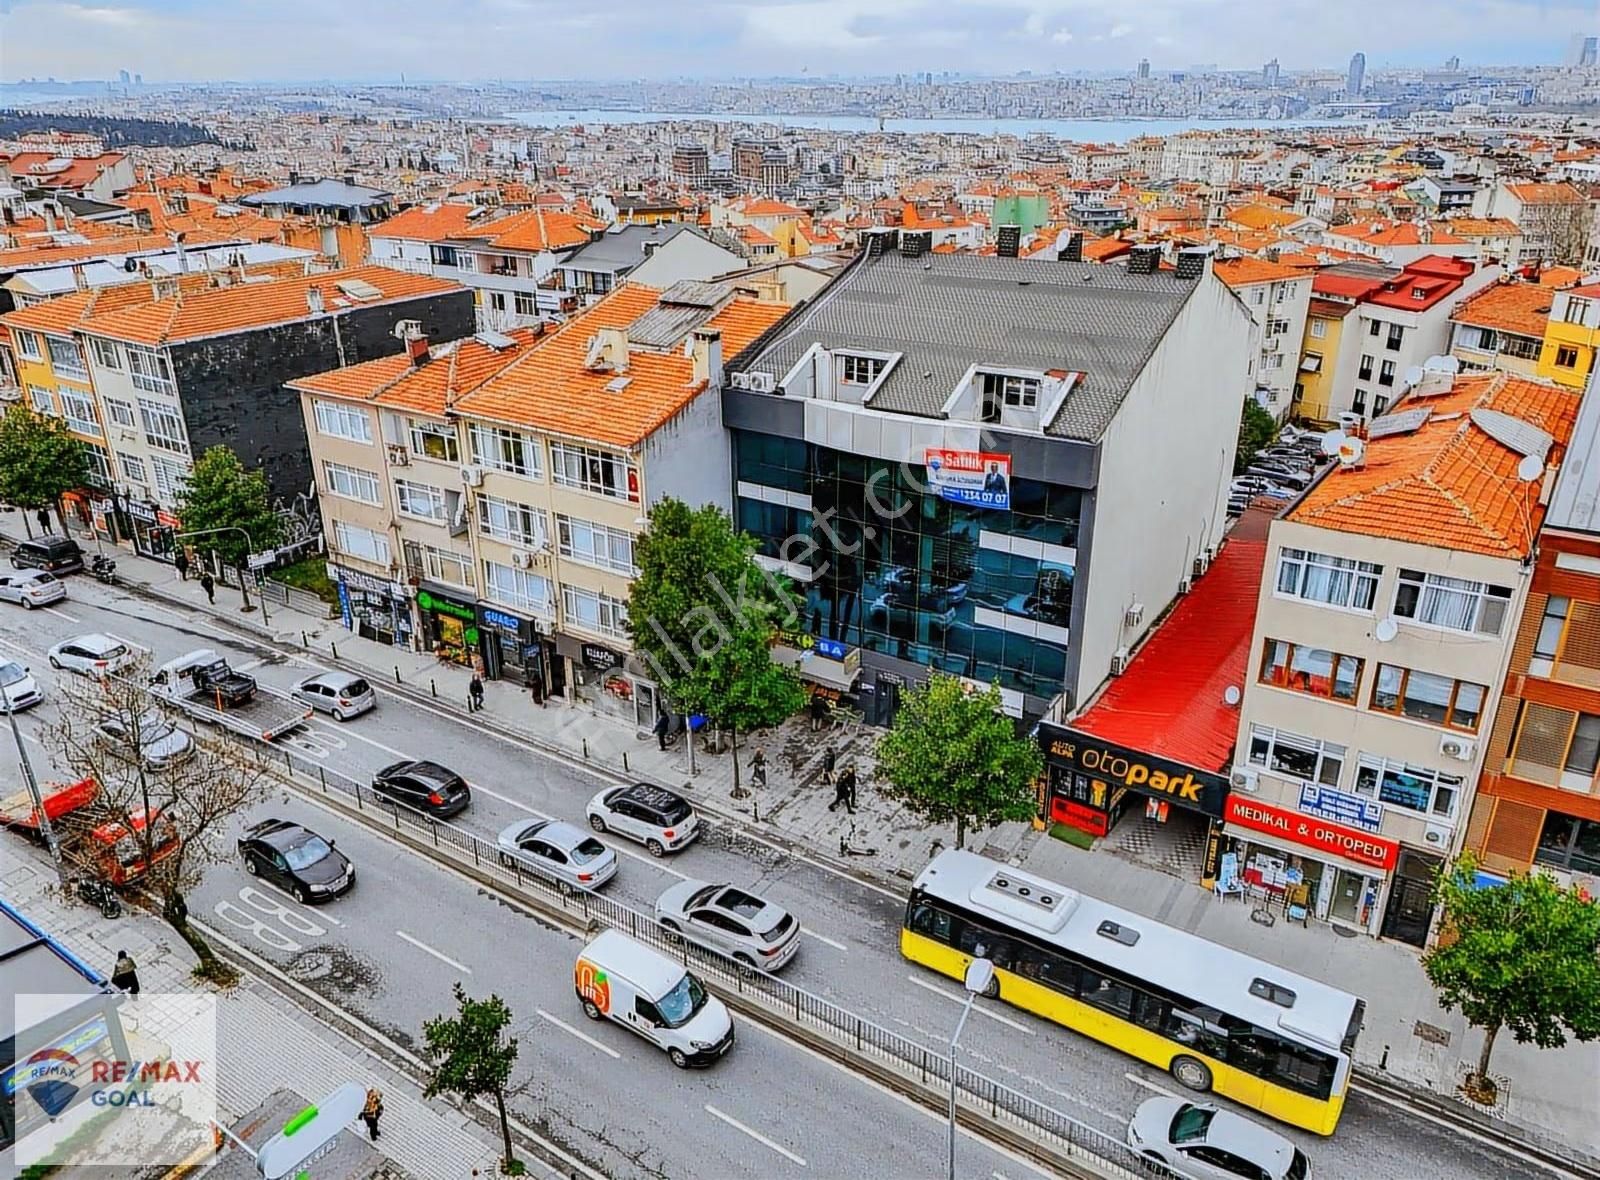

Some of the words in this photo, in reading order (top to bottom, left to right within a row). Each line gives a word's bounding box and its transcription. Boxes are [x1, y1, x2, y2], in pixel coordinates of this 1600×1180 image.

[1052, 740, 1076, 752] AUTO
[1082, 749, 1204, 802] otopark
[1233, 803, 1291, 831] MEDİKAL
[1297, 822, 1310, 837] &
